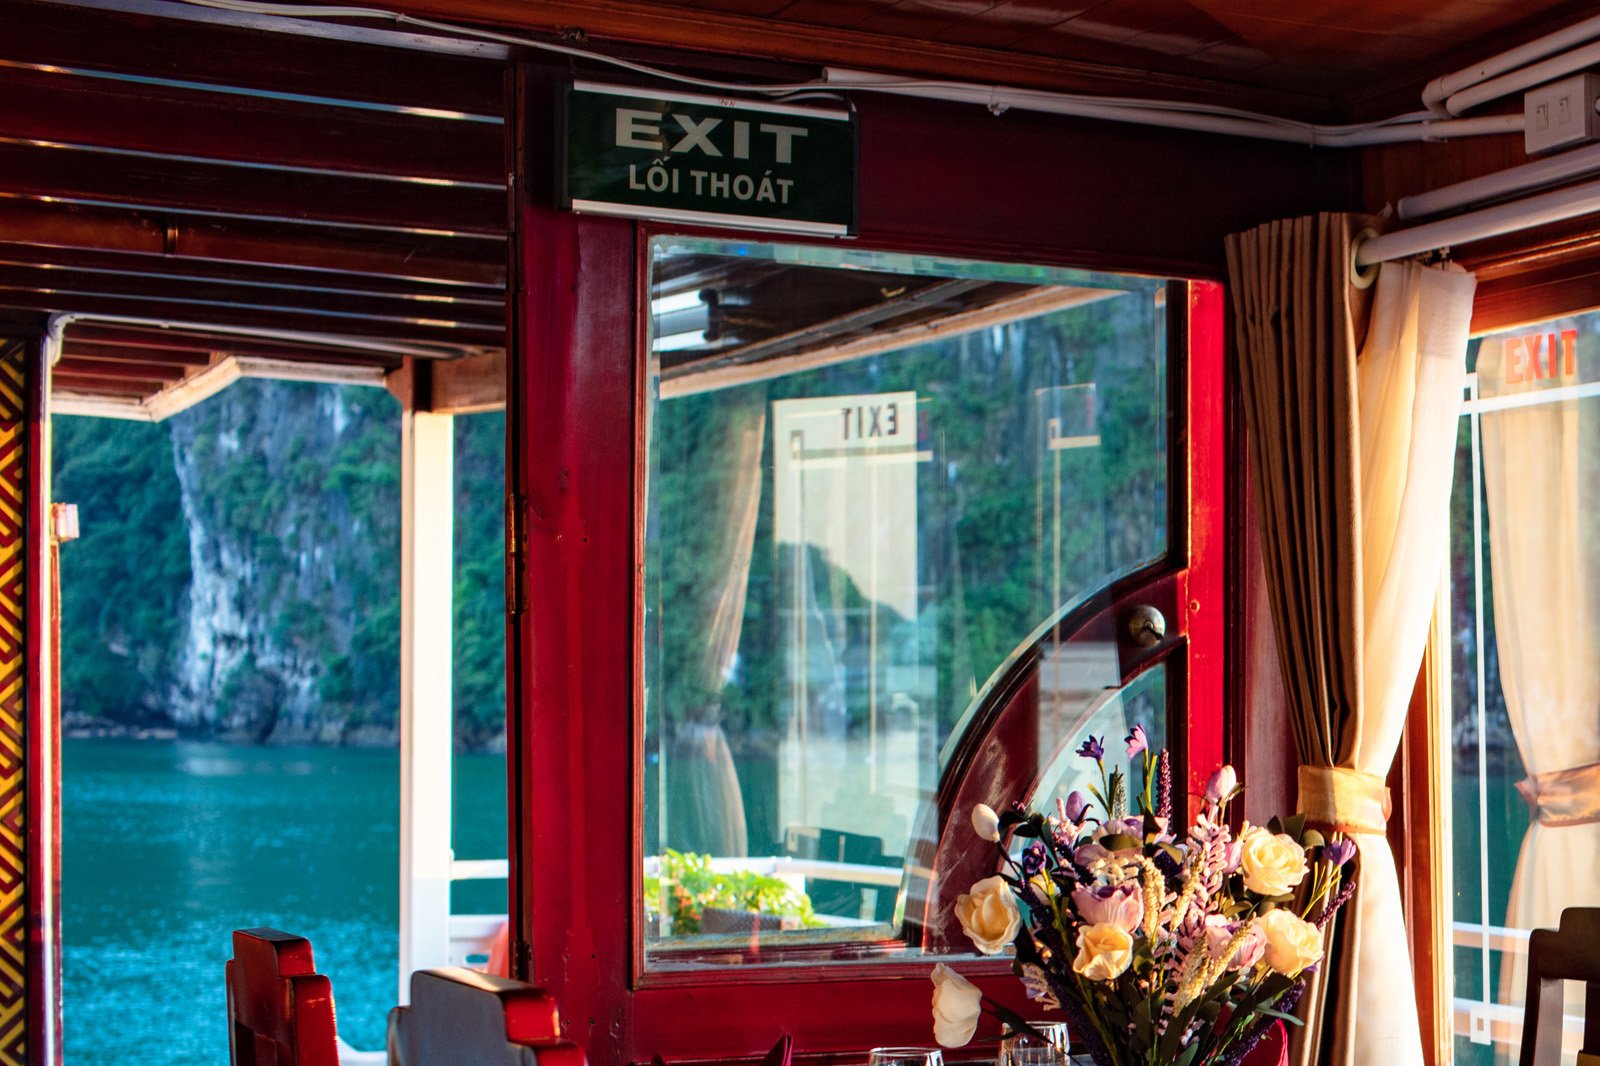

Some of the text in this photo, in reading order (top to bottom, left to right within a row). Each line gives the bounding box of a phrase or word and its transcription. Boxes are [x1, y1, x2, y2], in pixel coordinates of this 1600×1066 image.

[615, 107, 808, 164] EXIT
[629, 155, 795, 205] LỐI THOÁT
[1504, 329, 1578, 384] EXIT
